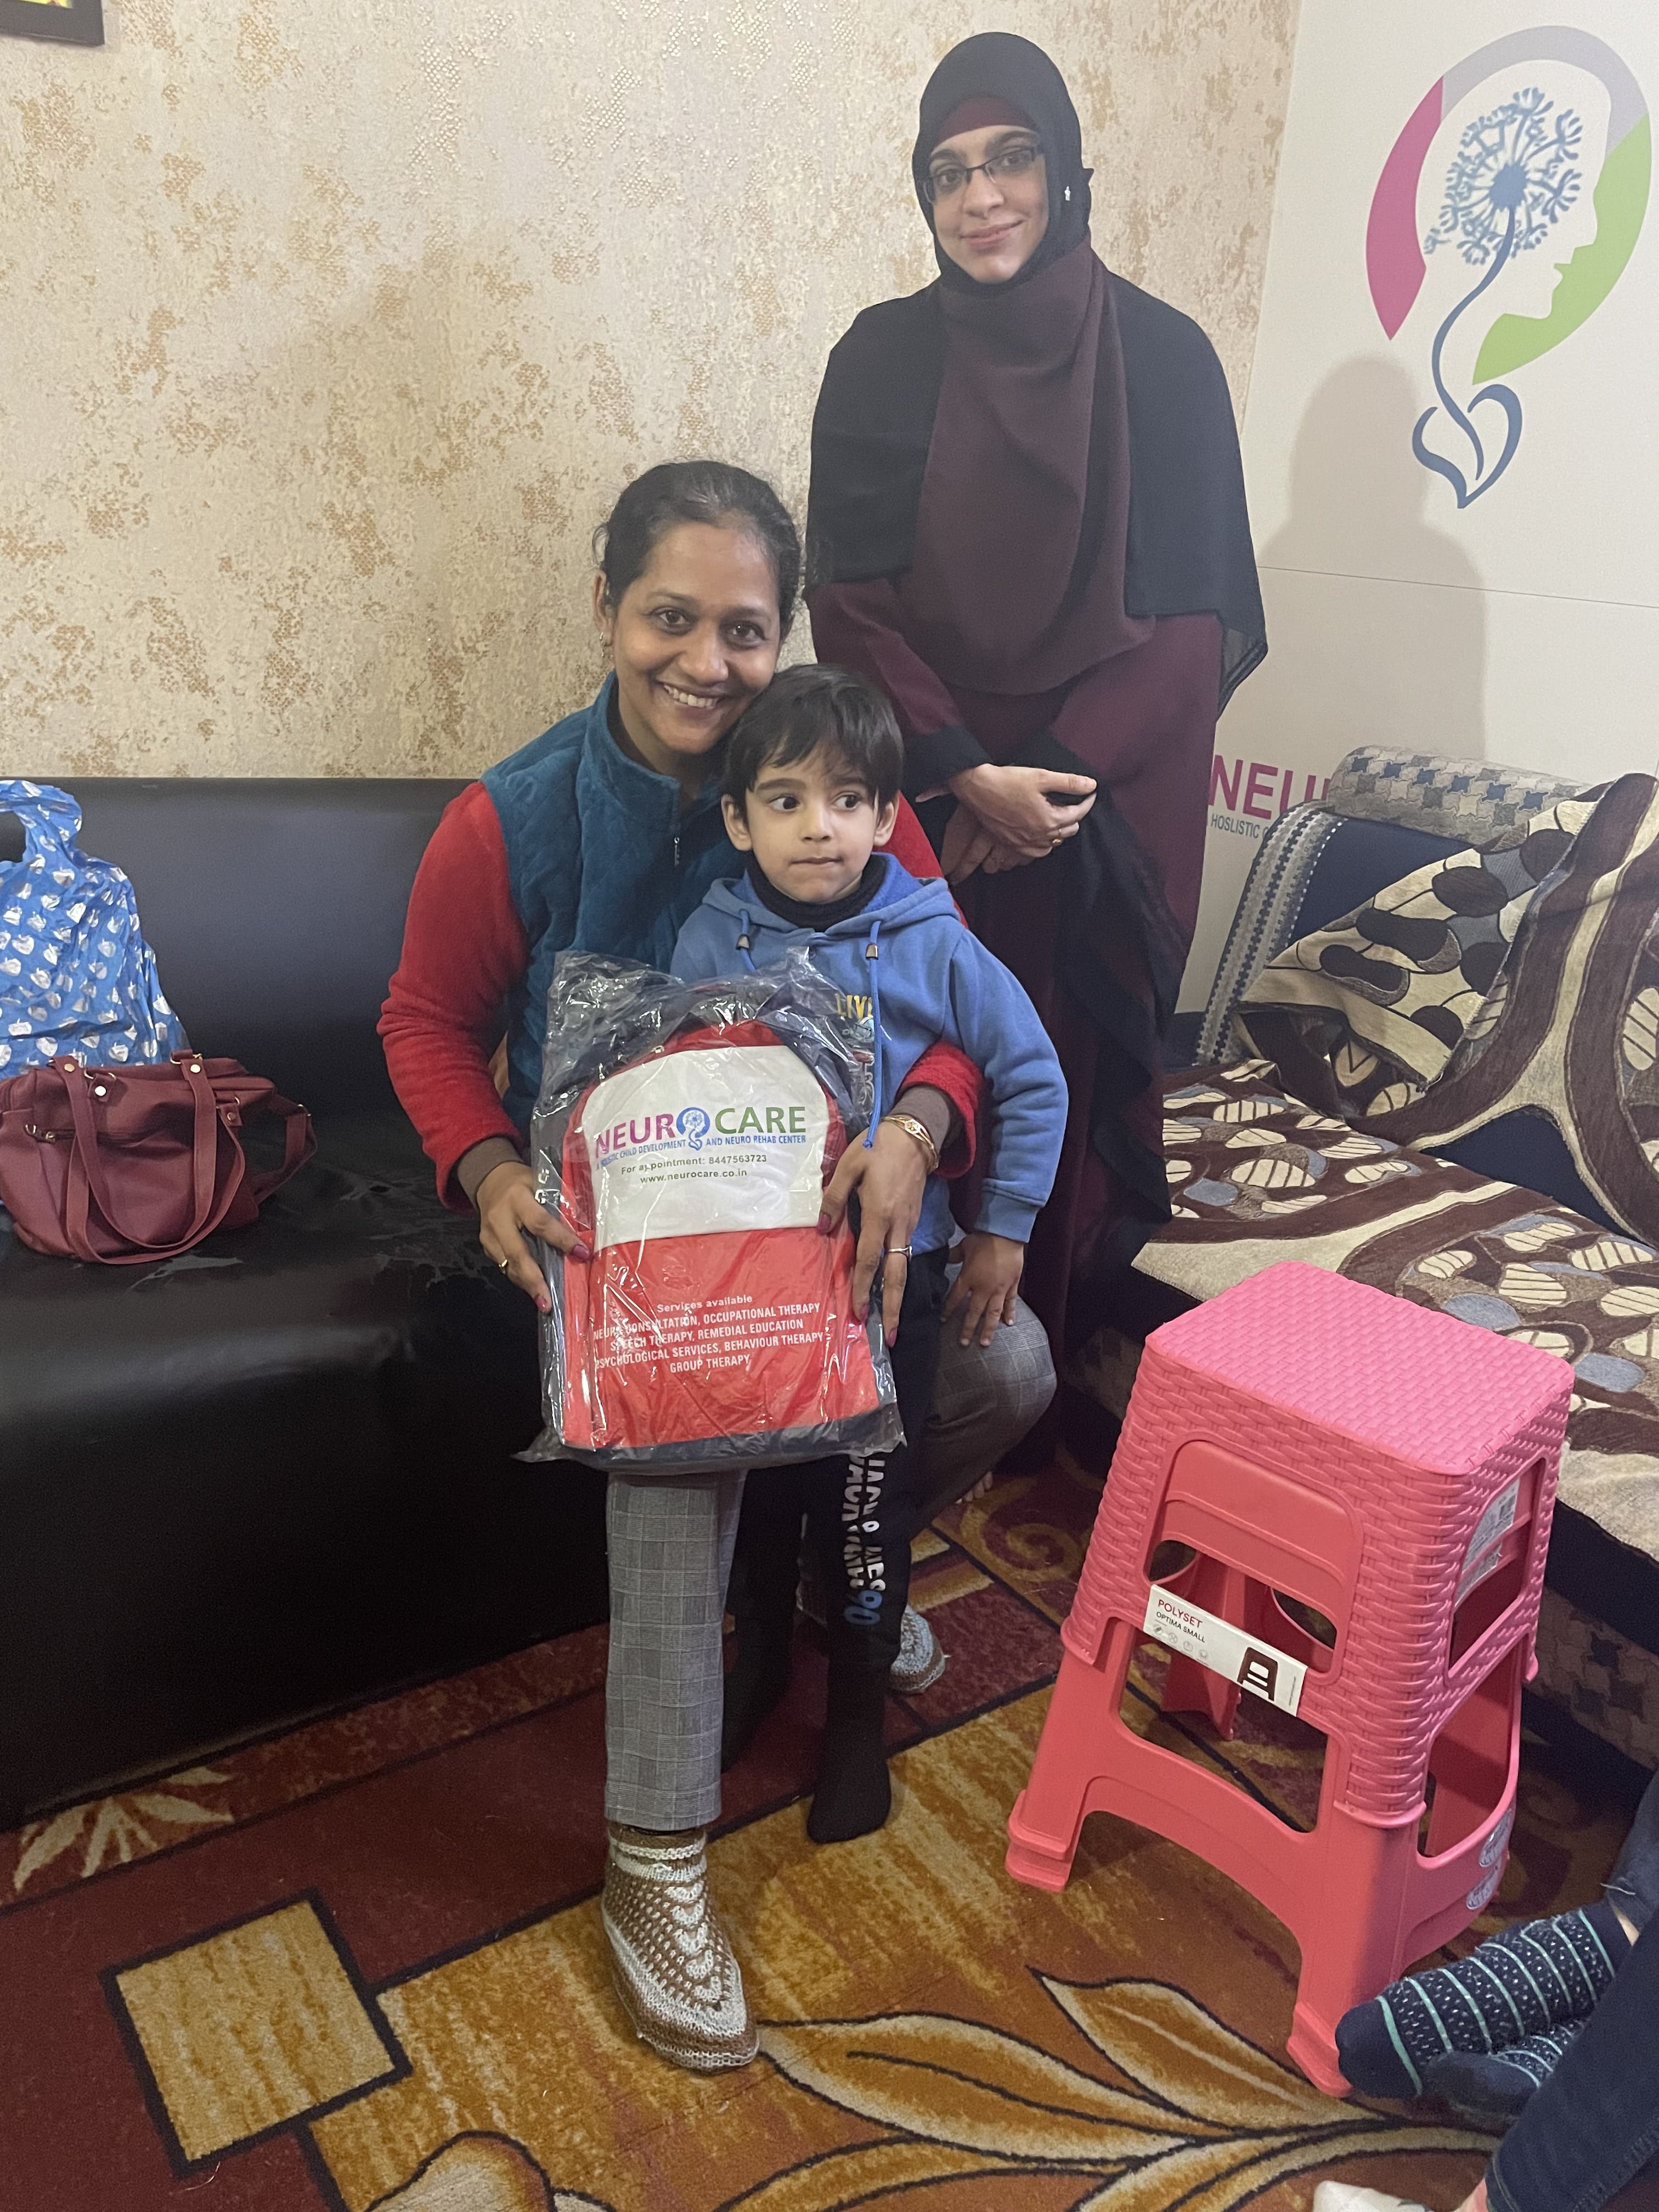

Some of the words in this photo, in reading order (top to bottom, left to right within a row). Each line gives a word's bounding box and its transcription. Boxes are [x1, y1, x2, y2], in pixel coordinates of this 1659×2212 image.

[1211, 813, 1261, 839] HOSLISTIC
[620, 1147, 637, 1158] CHILD
[639, 1139, 686, 1154] DEVELOPMENT
[706, 1137, 723, 1146] AND
[725, 1136, 751, 1144] NEURO
[754, 1135, 776, 1143] REHAB
[779, 1135, 806, 1143] CENTER
[621, 1166, 636, 1175] For
[709, 1155, 767, 1164] 8447563723
[640, 1169, 747, 1183] www.neurocare.co.in
[657, 1302, 702, 1313] Services
[706, 1295, 753, 1307] available
[594, 1325, 623, 1340] NEUR
[626, 1315, 700, 1334] CONSLTATION,
[703, 1307, 776, 1324] OCCUPATIONAL
[778, 1302, 820, 1316] THERAPY
[610, 1338, 647, 1351] SEECH
[698, 1325, 747, 1340] REMEDIAL
[750, 1319, 803, 1334] EDUCATION
[673, 1343, 721, 1357] SERVICES,
[724, 1336, 778, 1351] BEHAVIOUR
[781, 1332, 823, 1345] THERAPY
[670, 1360, 703, 1373] GROUP
[706, 1354, 750, 1368] THERAPY
[1158, 1599, 1203, 1628] POLYSET
[1156, 1612, 1182, 1629] OPTIMA
[1183, 1626, 1205, 1643] SMALL
